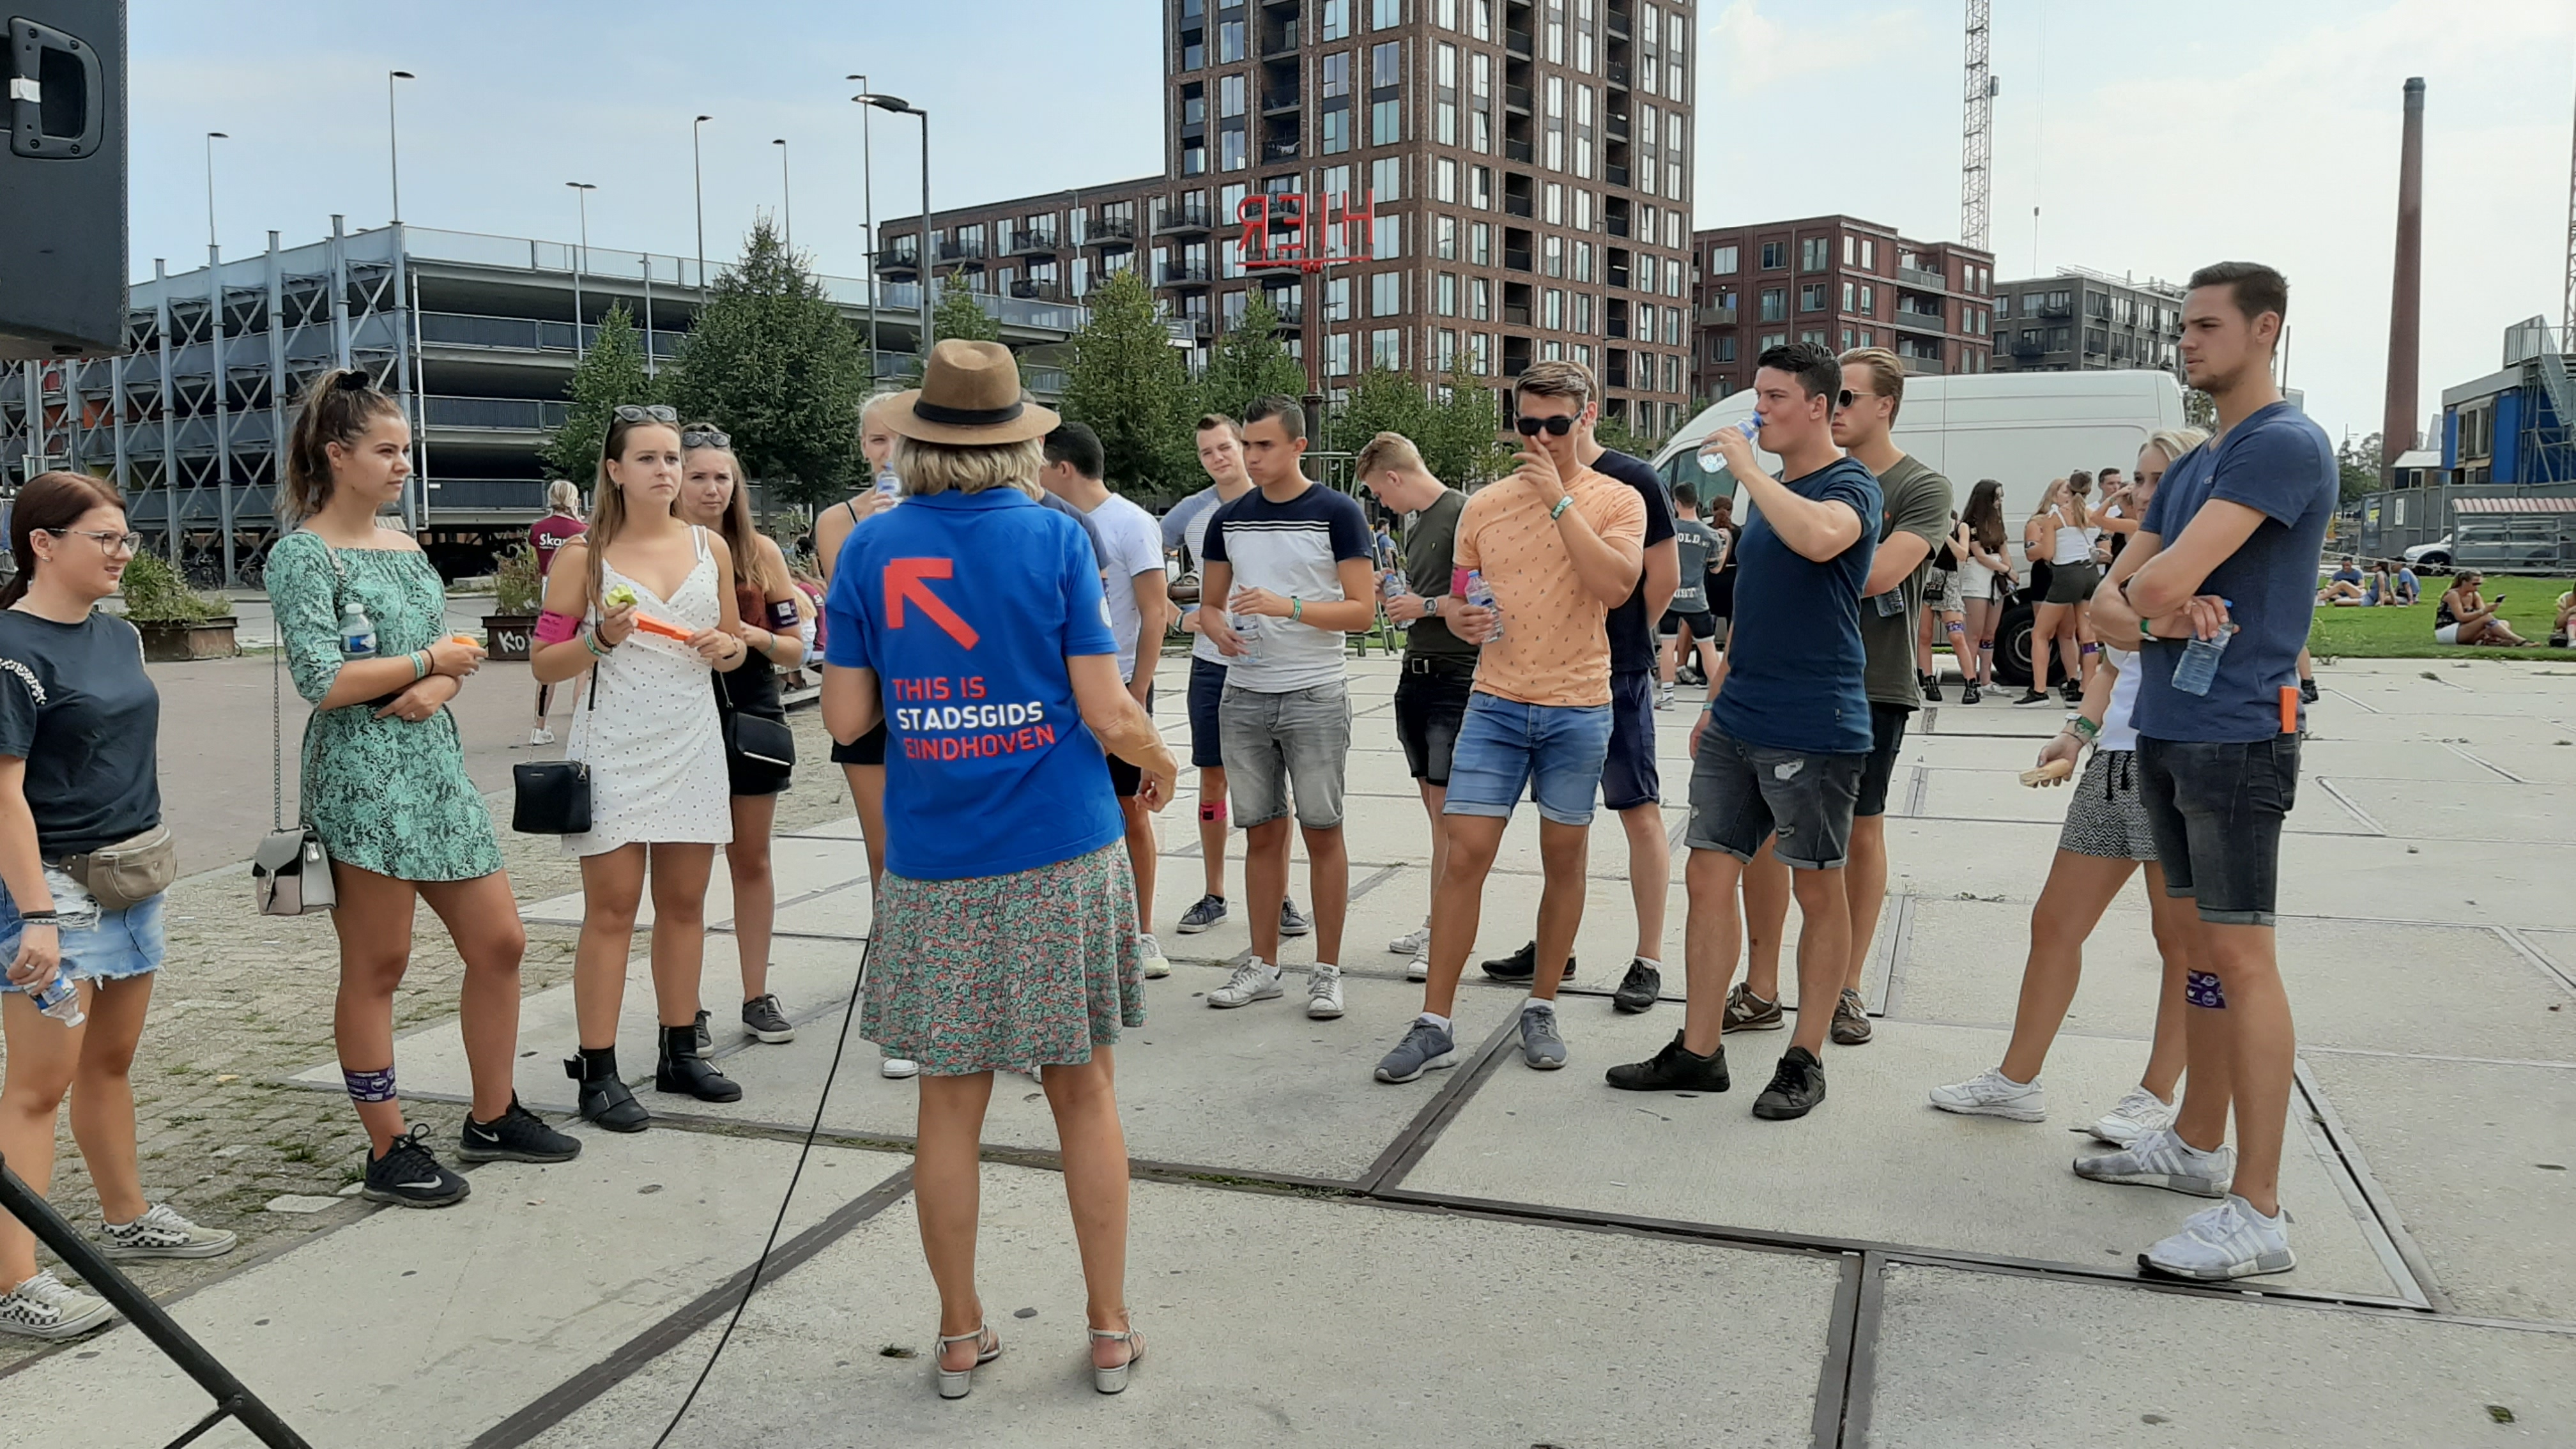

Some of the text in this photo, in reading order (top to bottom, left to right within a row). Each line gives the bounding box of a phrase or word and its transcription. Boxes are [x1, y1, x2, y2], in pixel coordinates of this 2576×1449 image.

[892, 676, 986, 701] THIS IS
[896, 701, 1044, 731] STADSGIDS
[904, 723, 1055, 761] EINDHOVEN
